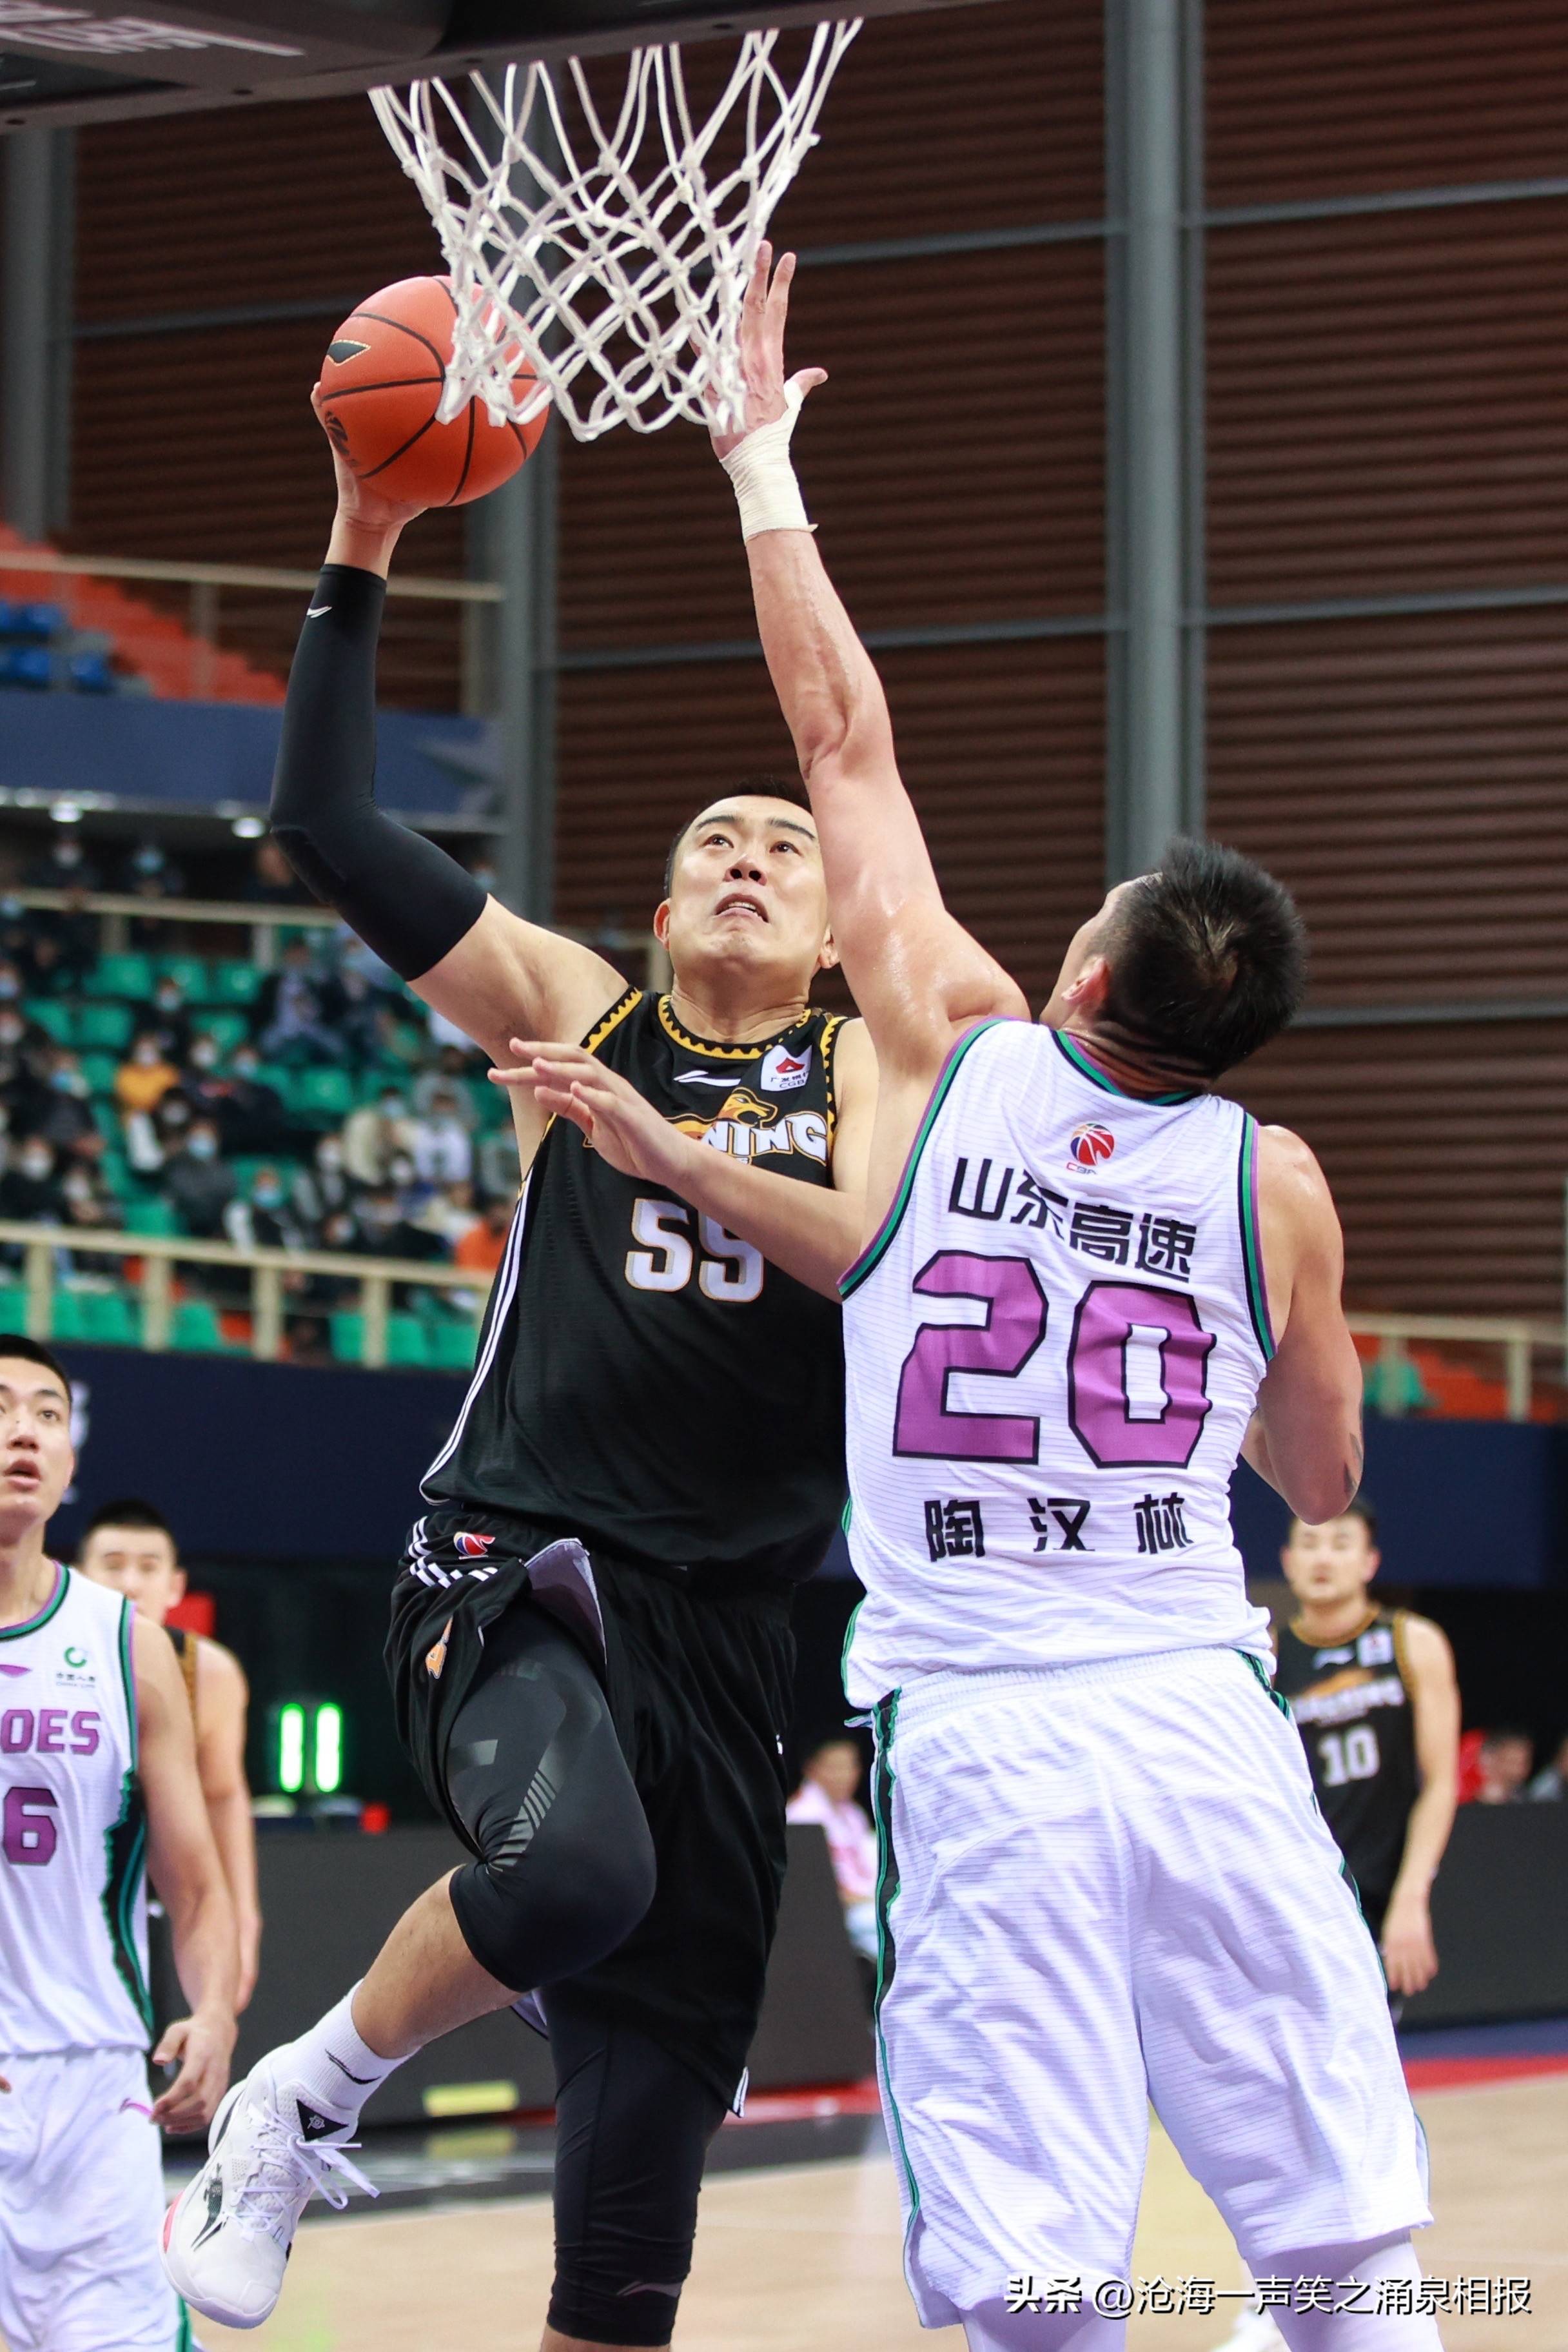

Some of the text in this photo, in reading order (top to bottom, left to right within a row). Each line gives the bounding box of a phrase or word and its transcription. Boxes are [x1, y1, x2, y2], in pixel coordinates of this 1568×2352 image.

[779, 1079, 805, 1088] CGB
[700, 1112, 828, 1166] NING
[624, 1197, 764, 1302] 55
[948, 1157, 1197, 1284] 山东高速
[892, 1249, 1217, 1469] 20
[923, 1492, 1194, 1562] 陶汉林
[1318, 1723, 1381, 1788] 10
[3, 1787, 59, 1867] 6
